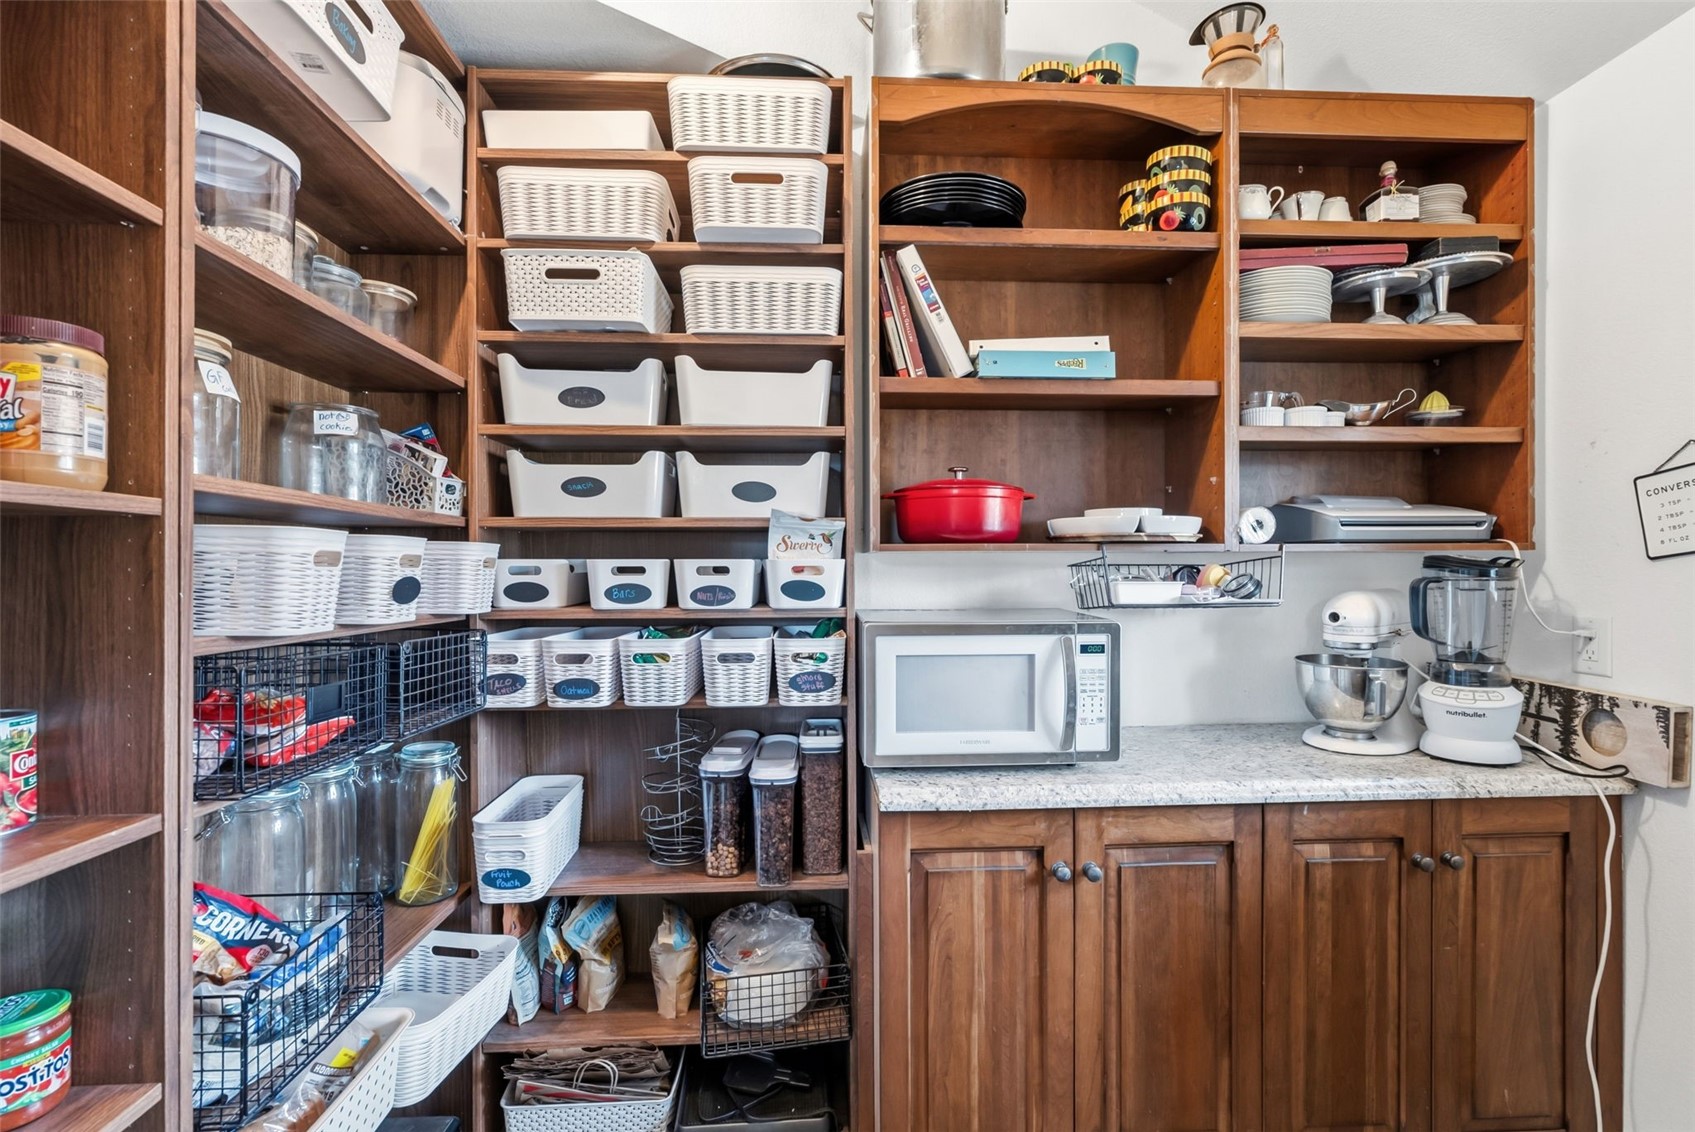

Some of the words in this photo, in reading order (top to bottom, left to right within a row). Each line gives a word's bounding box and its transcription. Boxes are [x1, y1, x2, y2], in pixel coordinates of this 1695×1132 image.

[1665, 511, 1684, 519] TBSP
[1668, 523, 1687, 531] TBSP
[776, 535, 830, 554] Swerve
[612, 587, 636, 599] Bars
